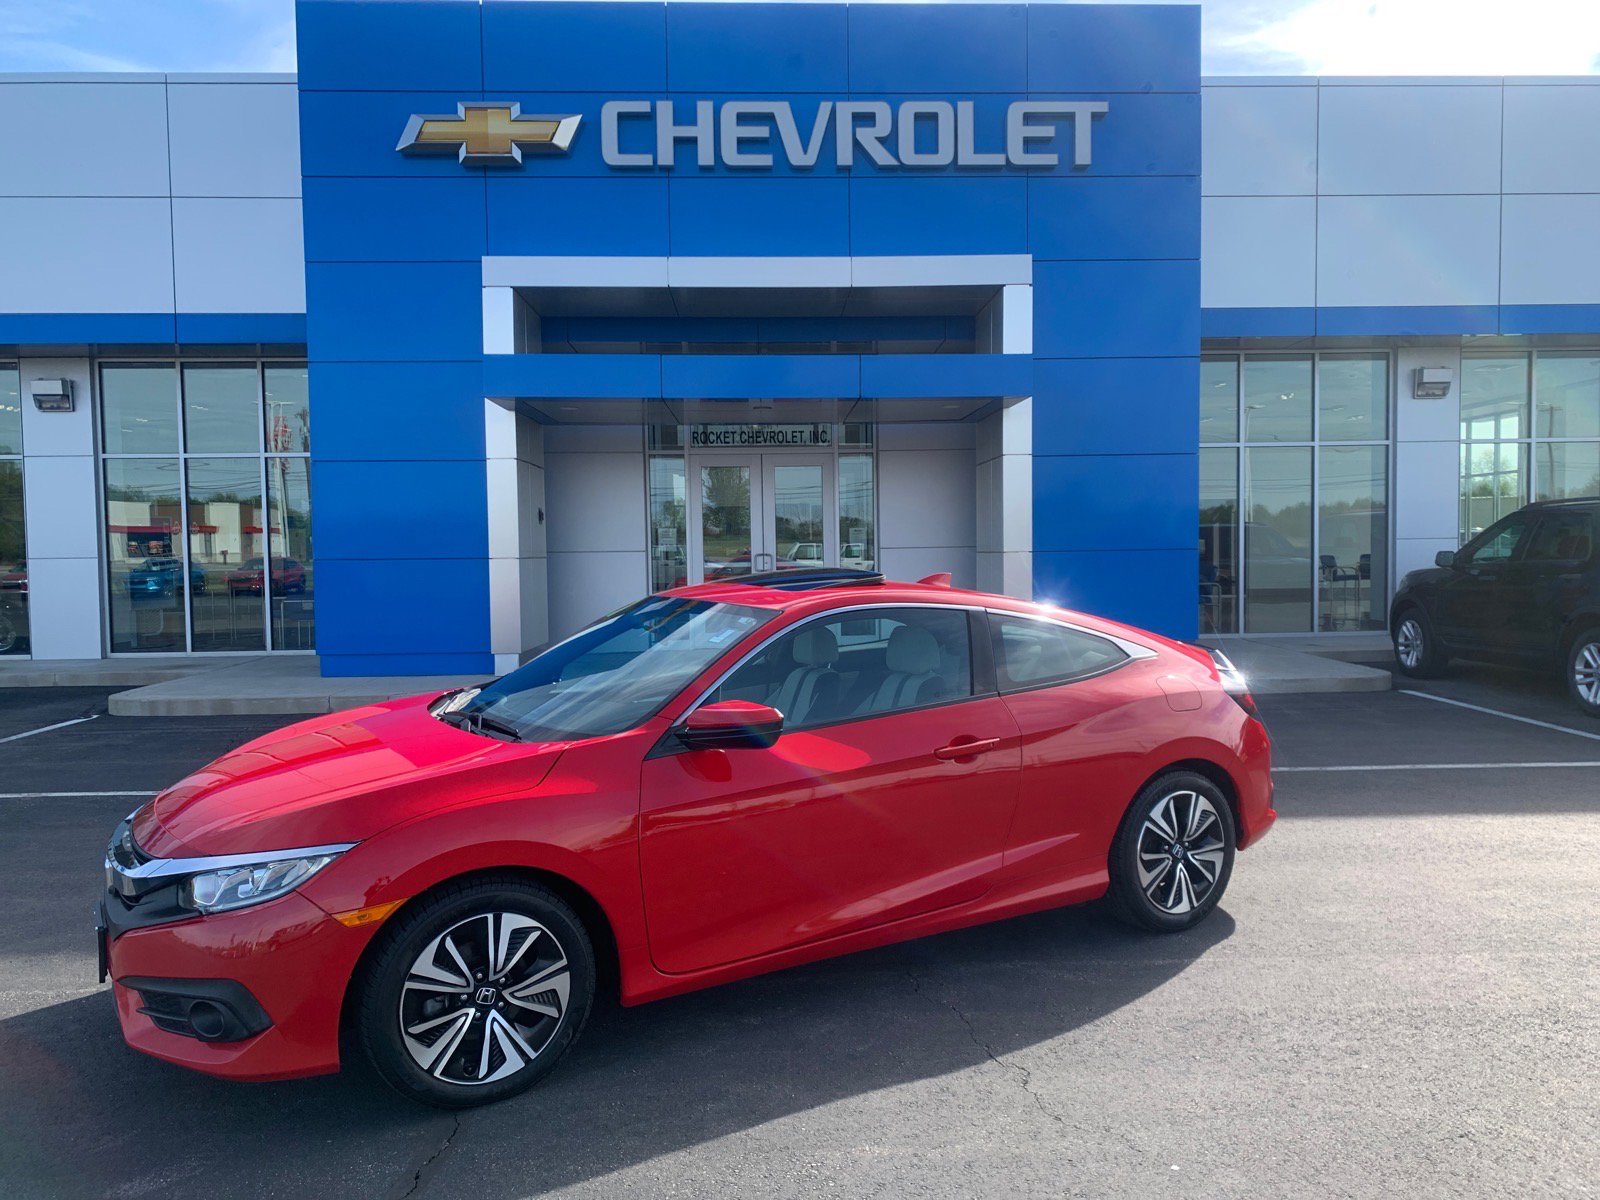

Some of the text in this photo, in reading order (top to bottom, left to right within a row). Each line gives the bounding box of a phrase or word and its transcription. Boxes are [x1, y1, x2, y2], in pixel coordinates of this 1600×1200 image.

[600, 100, 1109, 168] CHEVROLET
[692, 431, 737, 445] ROCKET
[809, 430, 831, 443] INC.
